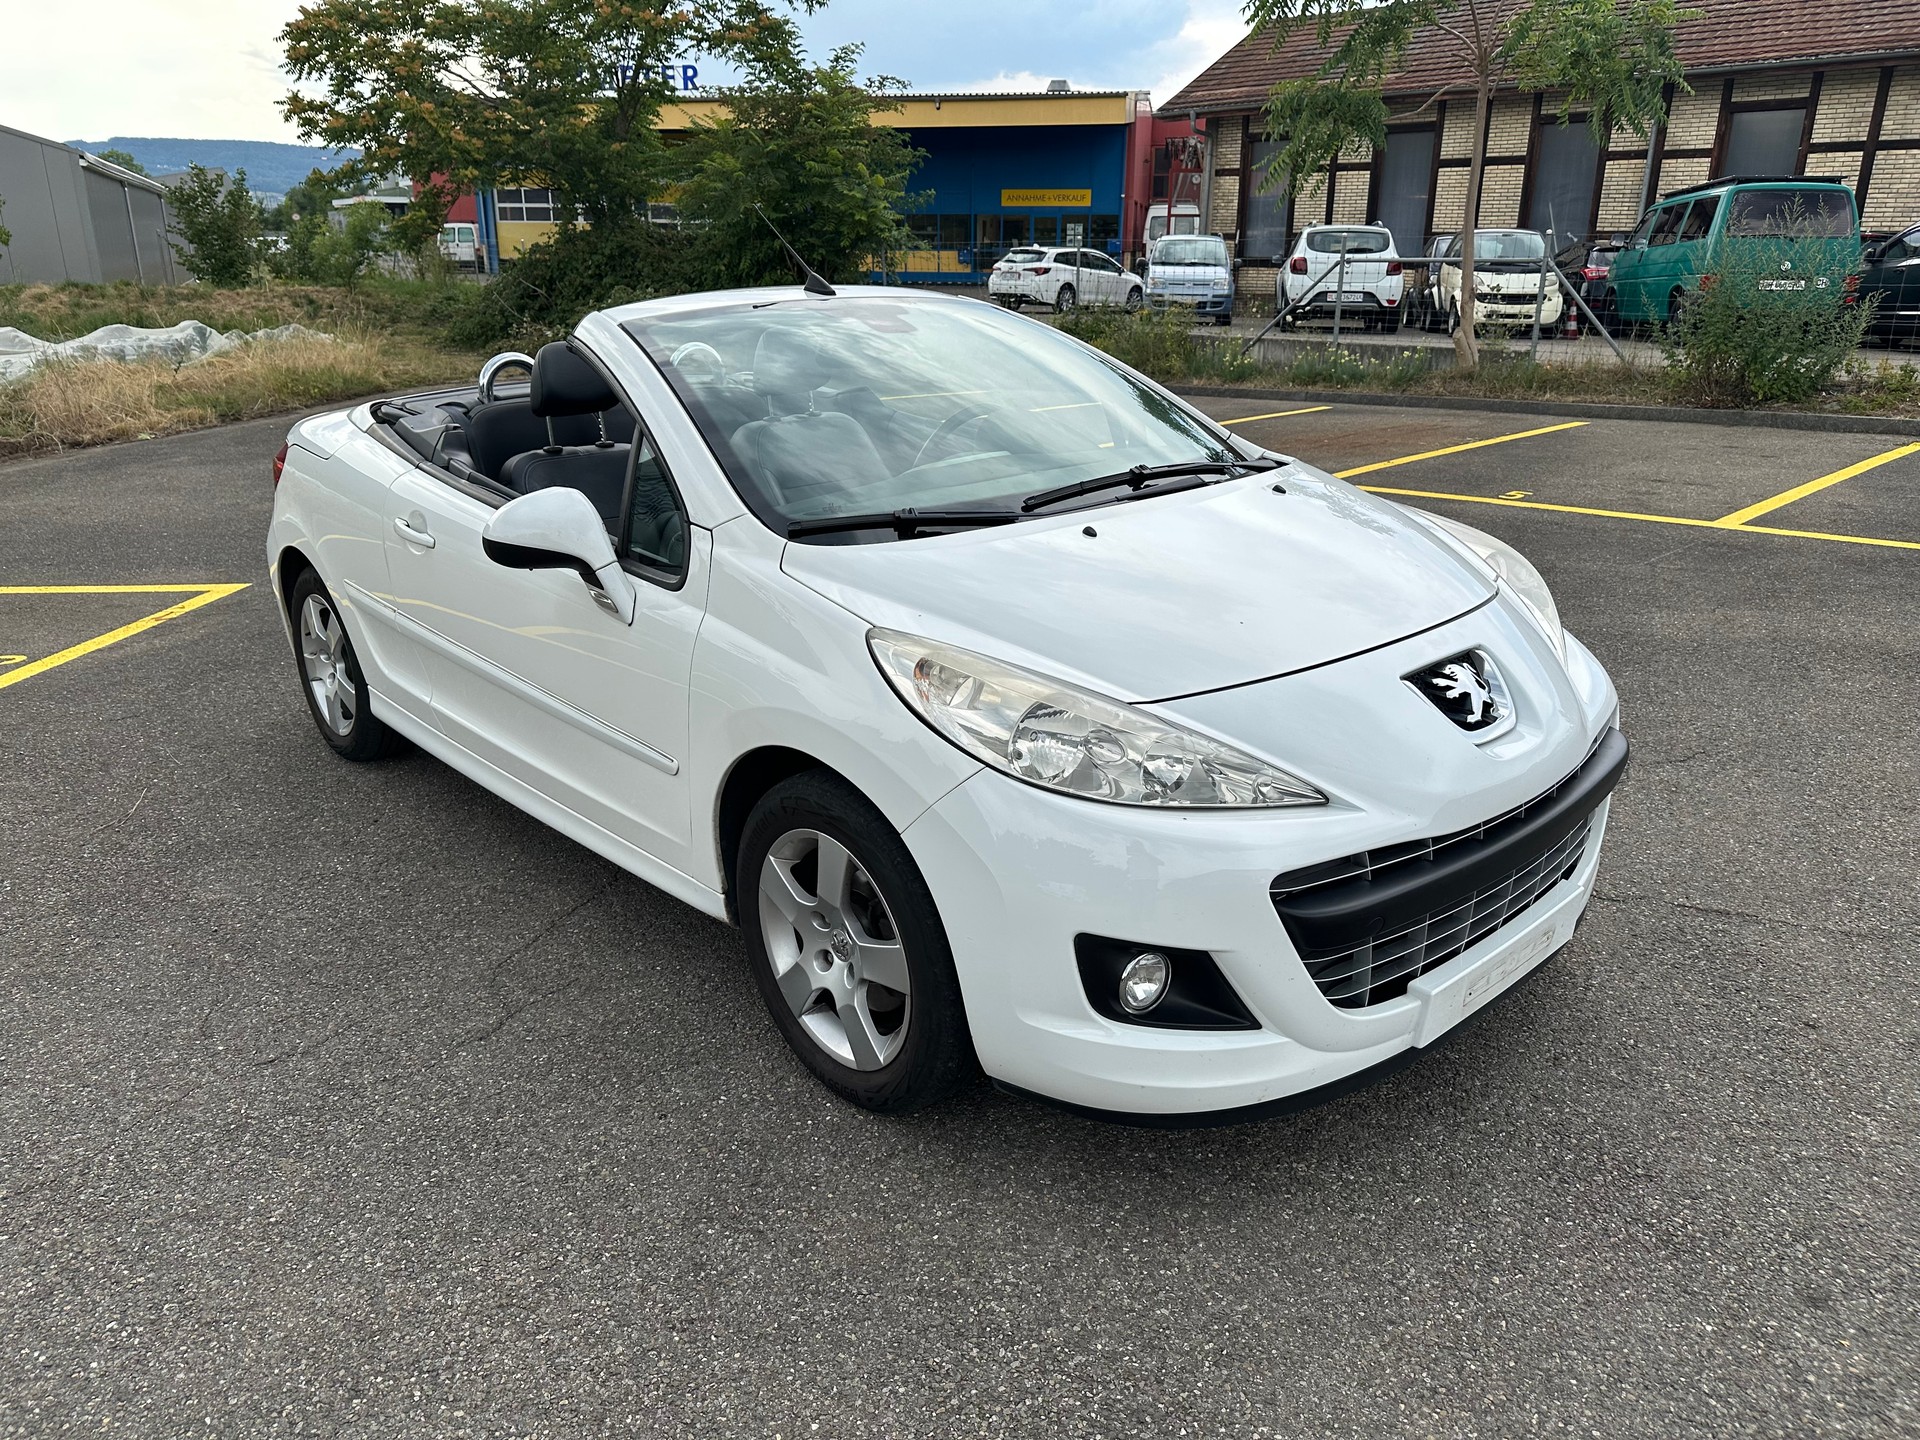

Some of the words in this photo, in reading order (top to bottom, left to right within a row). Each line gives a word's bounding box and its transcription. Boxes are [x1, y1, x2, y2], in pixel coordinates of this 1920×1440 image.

[1006, 193, 1046, 202] ANNAHME
[1053, 193, 1087, 202] VERKAUF
[1498, 490, 1534, 500] 5
